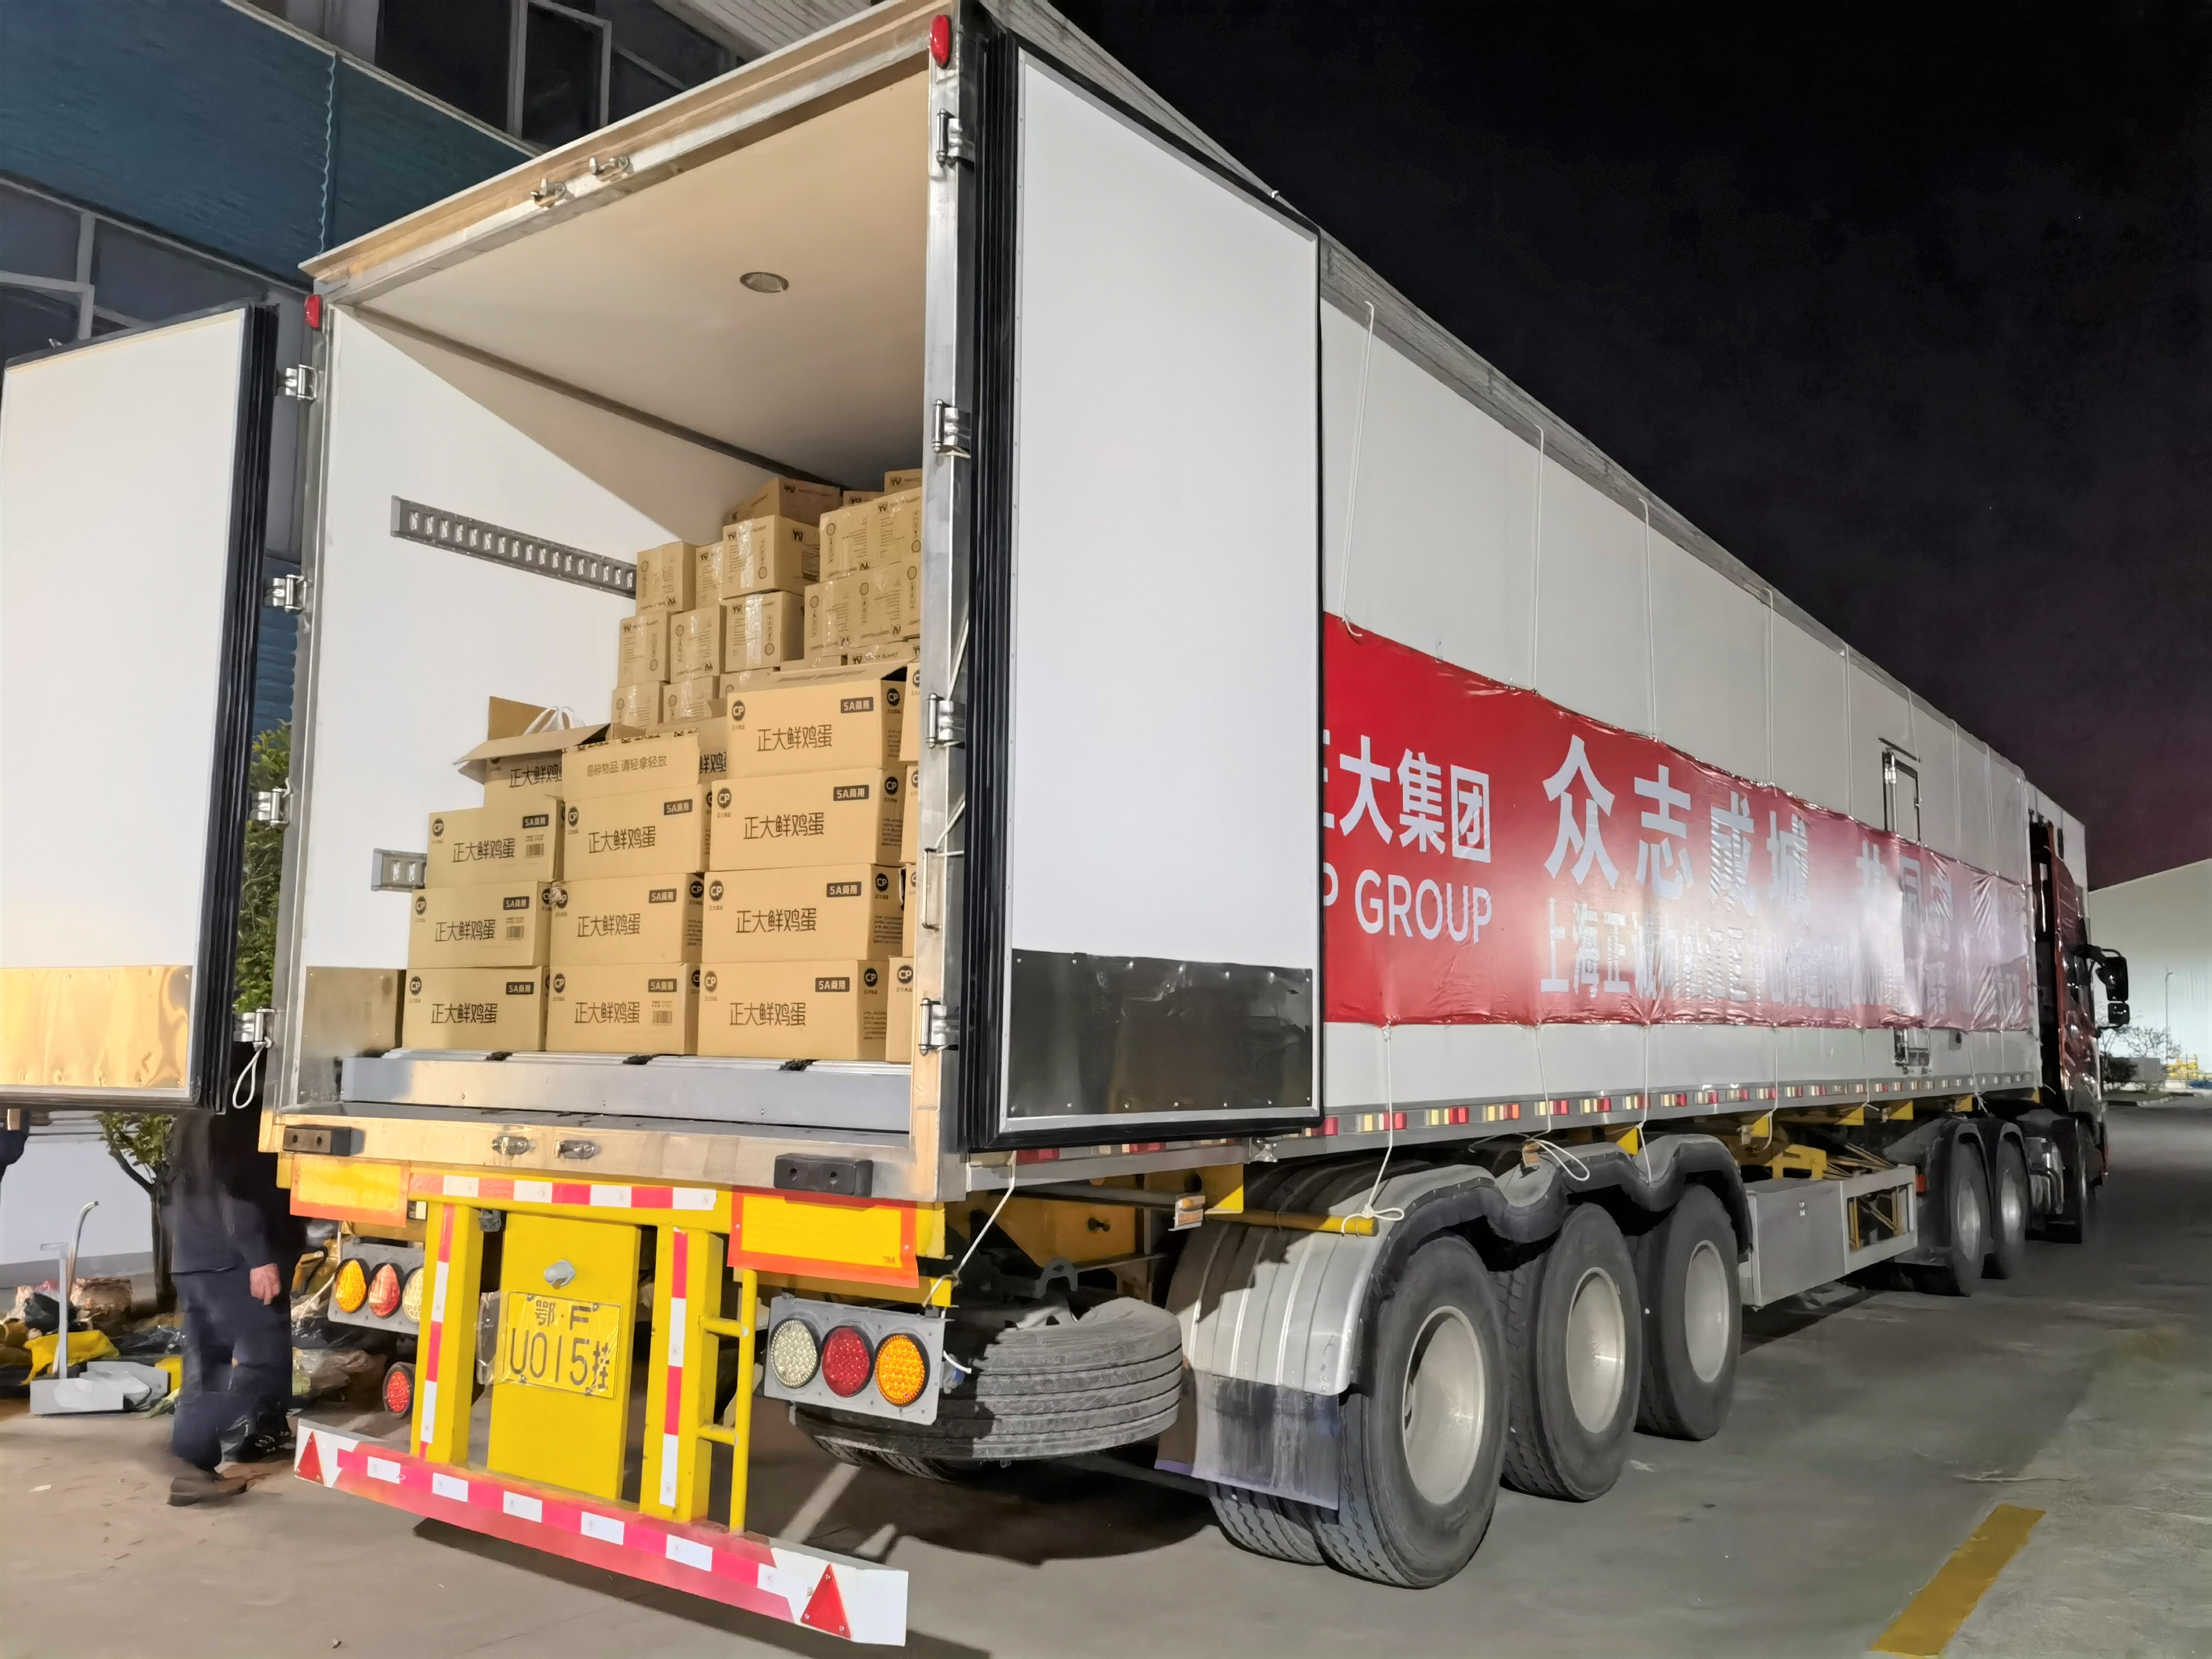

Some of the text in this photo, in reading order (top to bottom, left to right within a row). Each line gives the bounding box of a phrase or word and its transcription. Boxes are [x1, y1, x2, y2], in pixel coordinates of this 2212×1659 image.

[757, 724, 832, 751] 正大鲜鸡蛋
[509, 763, 563, 788] 正大鲜鸡
[744, 813, 824, 839] 正大鲜鸡蛋
[453, 838, 515, 862] 正大鲜鸡蛋
[589, 826, 656, 854] 正大鲜鸡蛋
[1354, 869, 1492, 945] GROUP
[435, 920, 495, 942] 正大鲜鸡蛋
[577, 914, 640, 938] 正大鲜鸡蛋
[736, 908, 817, 933] 正大鲜鸡蛋
[431, 1003, 498, 1024] 正大鲜鸡蛋
[575, 1002, 640, 1023] 正大鲜鸡蛋
[730, 1002, 806, 1026] 正大鲜鸡蛋
[510, 1327, 611, 1390] U015挂
